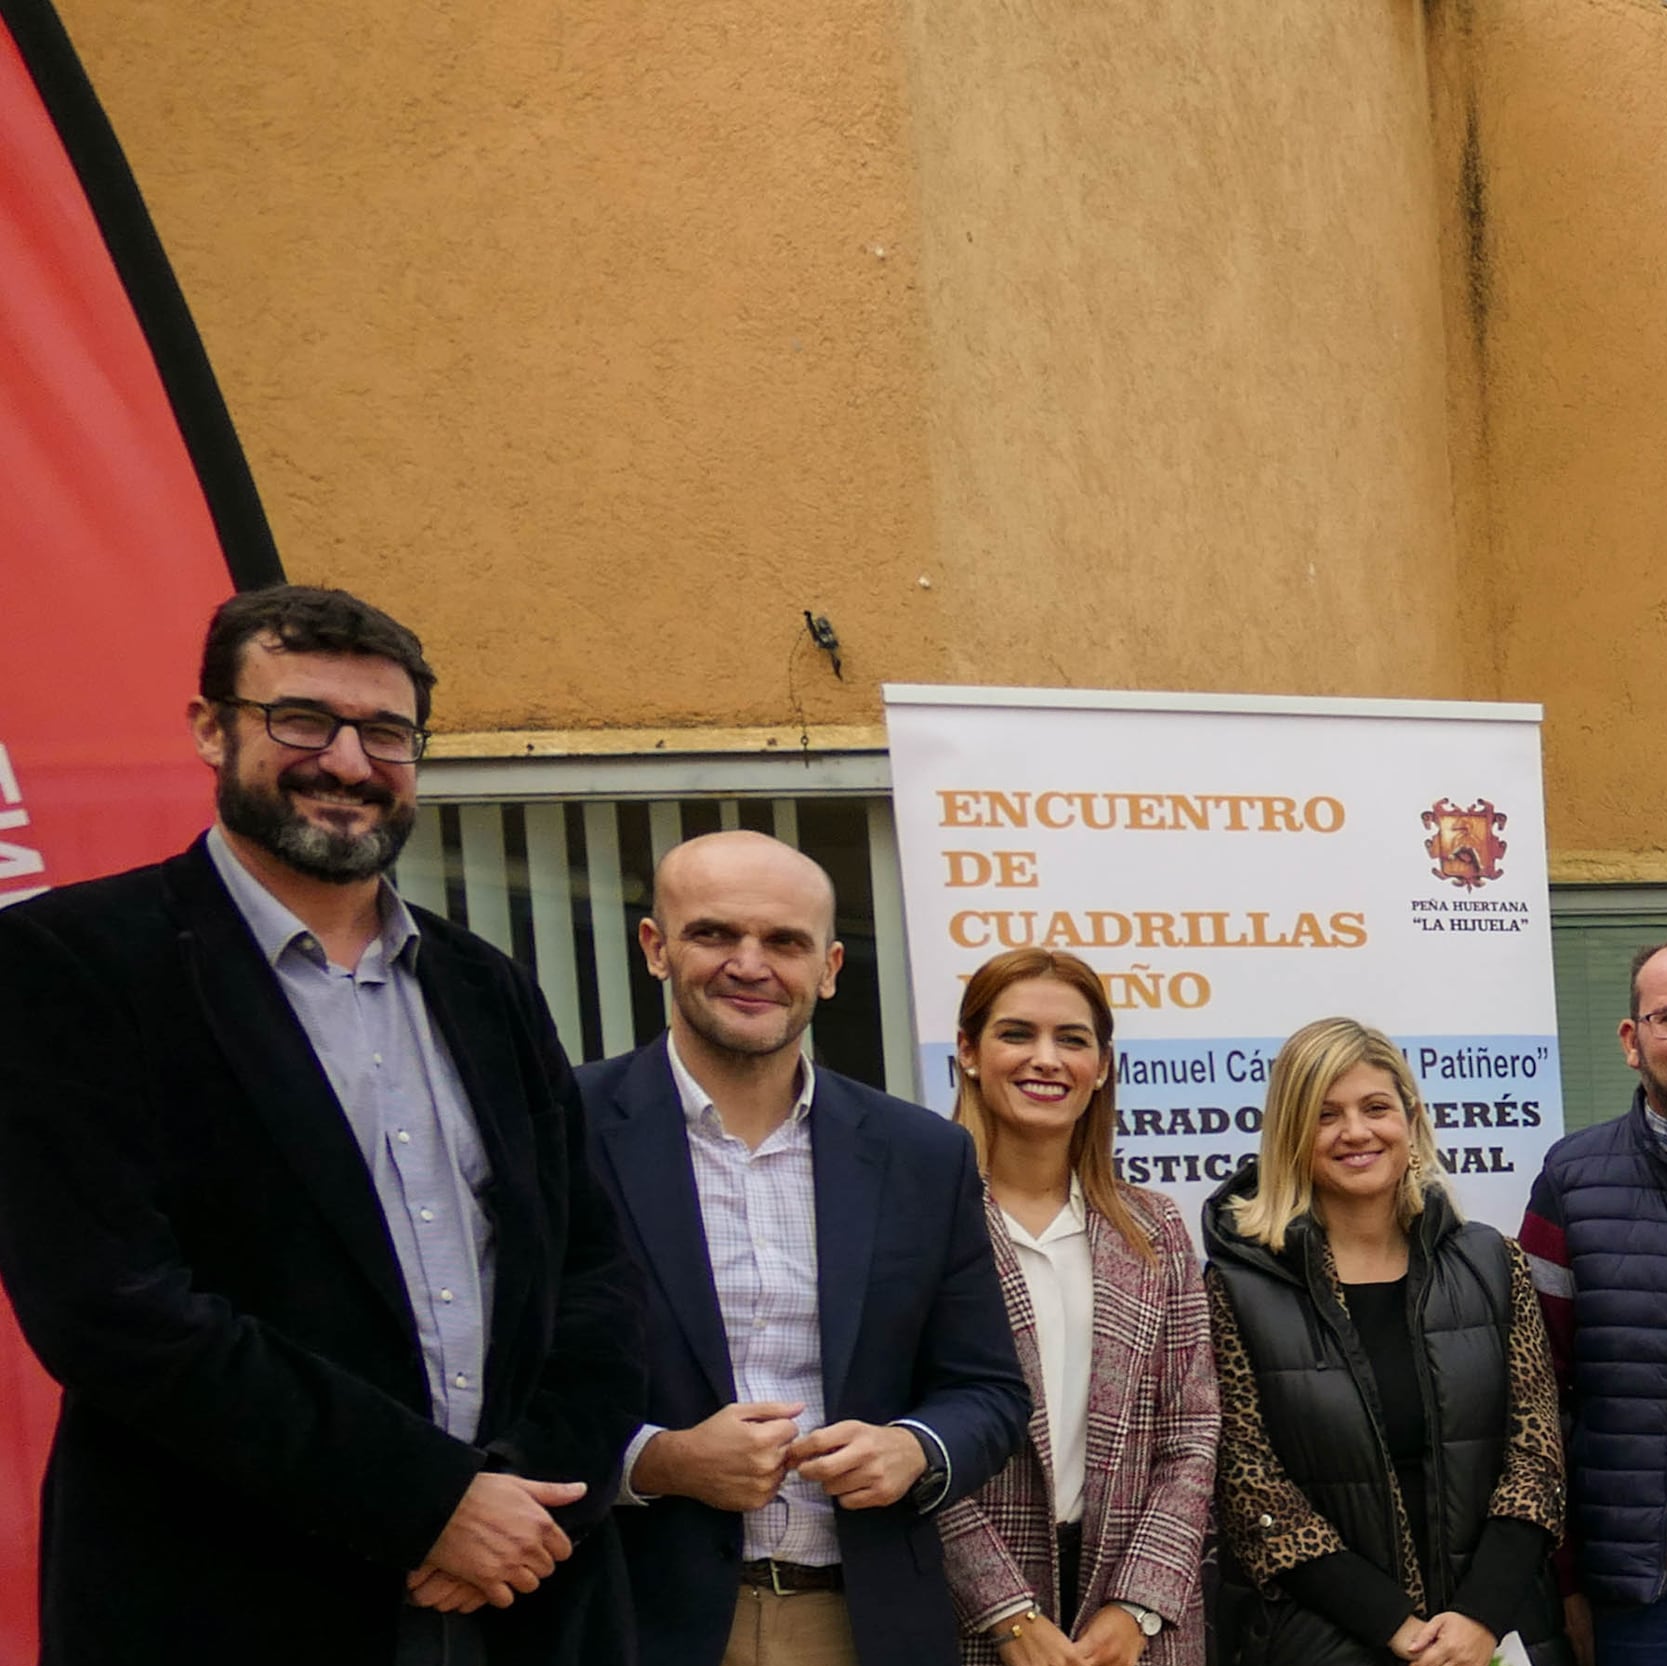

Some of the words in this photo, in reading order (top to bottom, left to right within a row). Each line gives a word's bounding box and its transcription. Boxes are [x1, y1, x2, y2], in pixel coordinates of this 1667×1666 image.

[936, 790, 1345, 833] ENCUENTRO
[942, 851, 1038, 888] DE
[1411, 898, 1449, 912] PEÑA
[1453, 901, 1529, 913] HUERTANA
[949, 910, 1367, 949] CUADRILLAS
[1420, 1047, 1549, 1080] Patiñero”
[1116, 1106, 1263, 1136] ARADO
[1434, 1094, 1541, 1129] ERÉS
